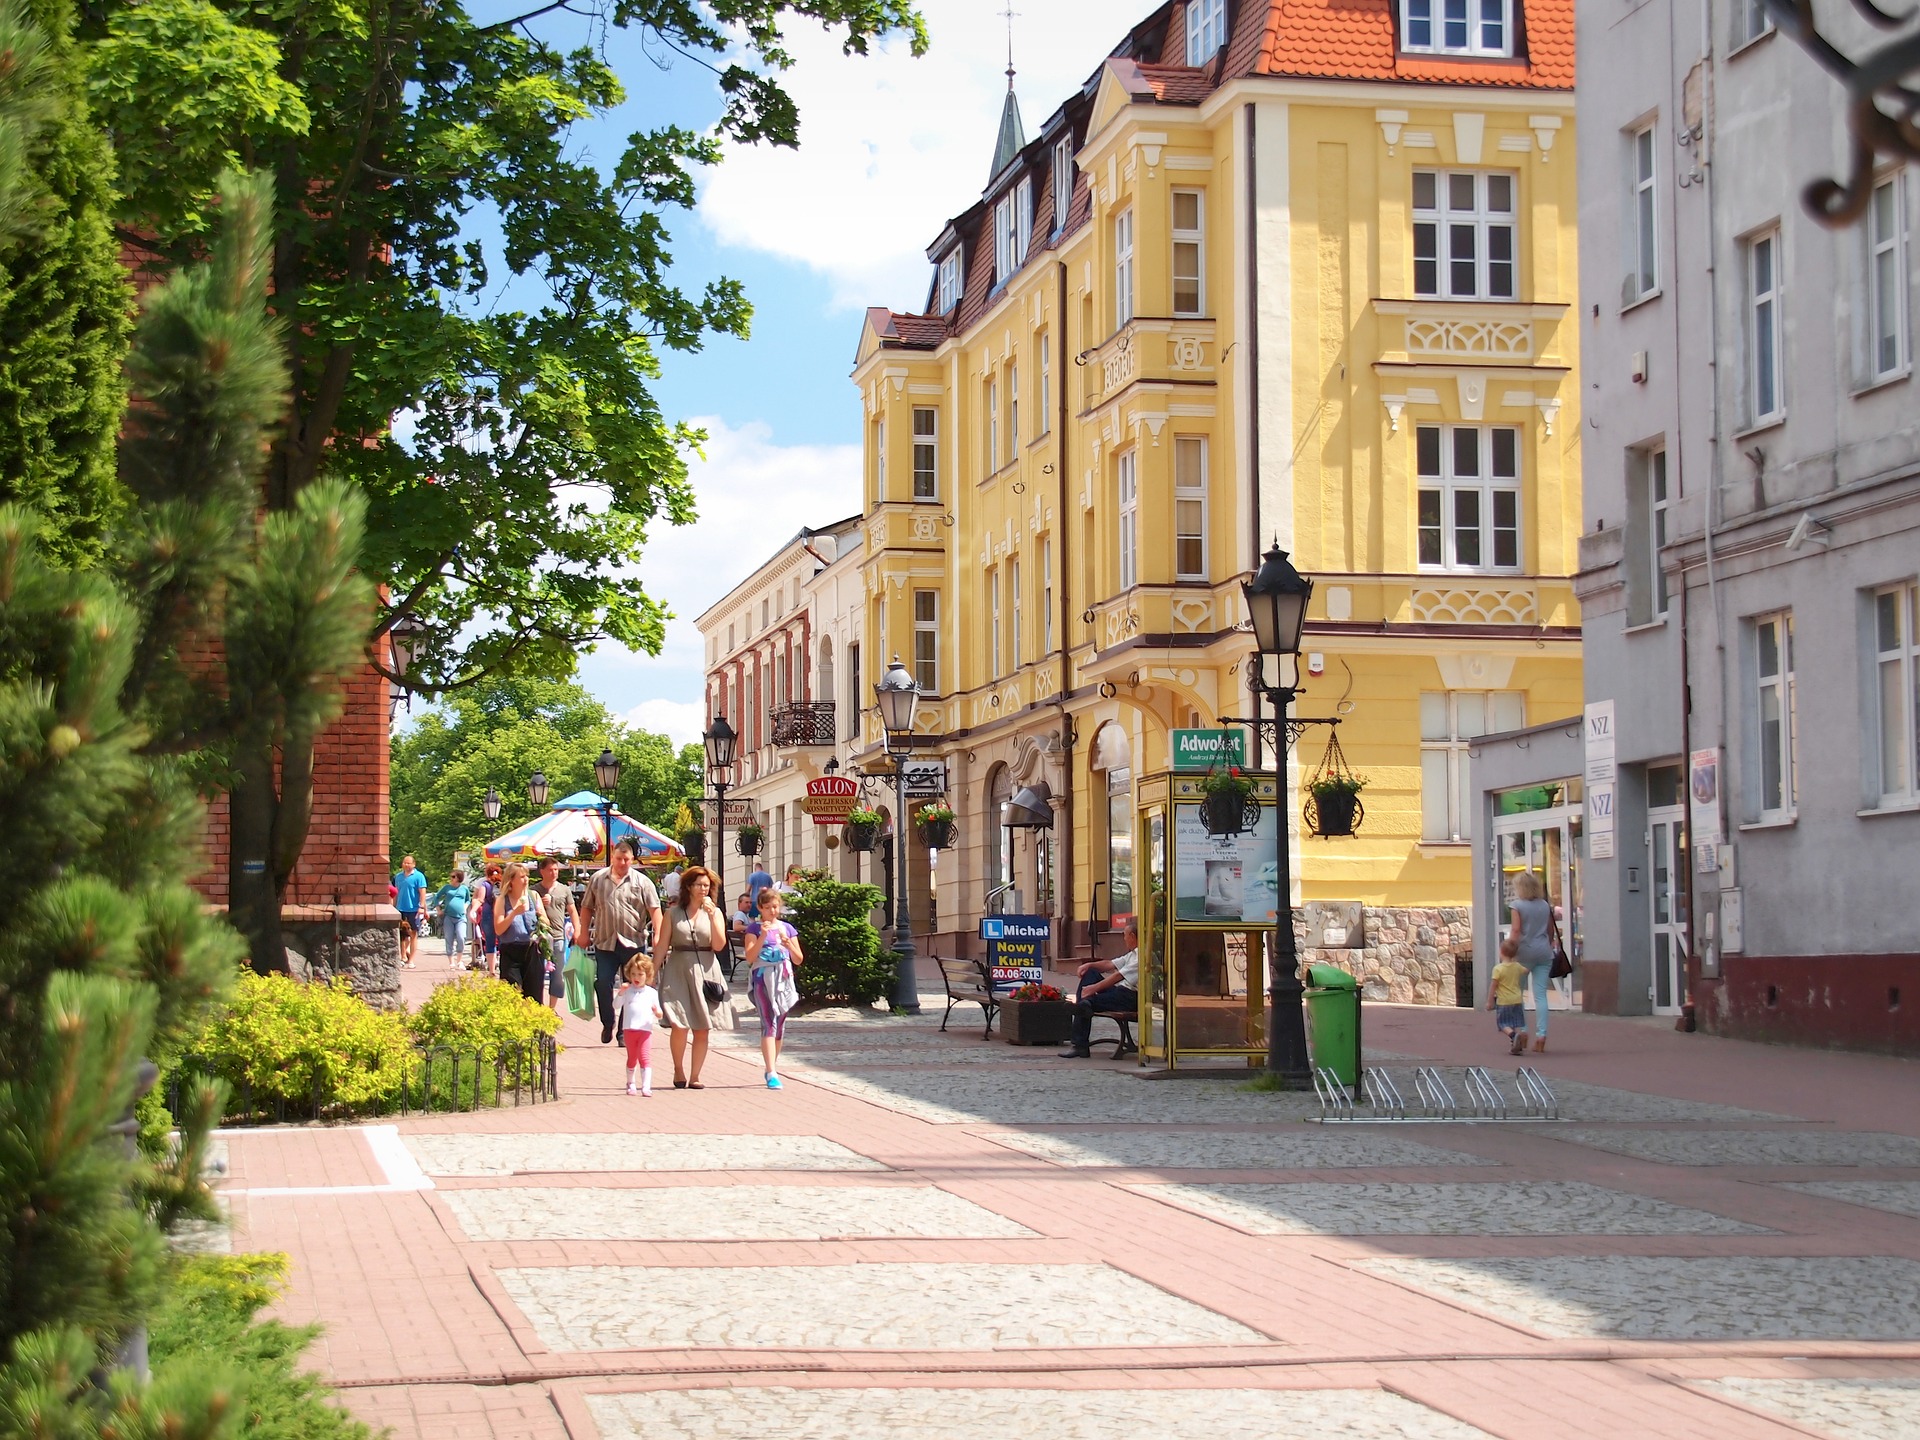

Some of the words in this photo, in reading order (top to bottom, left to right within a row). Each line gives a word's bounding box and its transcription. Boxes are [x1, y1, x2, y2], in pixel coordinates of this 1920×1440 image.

[1180, 734, 1241, 752] Adwokat
[811, 779, 853, 795] SALON
[809, 797, 855, 805] FRYZJERSKO
[723, 804, 745, 813] KLEP
[806, 805, 854, 813] KOSMETYCZN
[987, 922, 999, 937] L
[1003, 925, 1049, 936] Michał
[997, 942, 1035, 955] Nowy
[998, 955, 1035, 966] Kurs:
